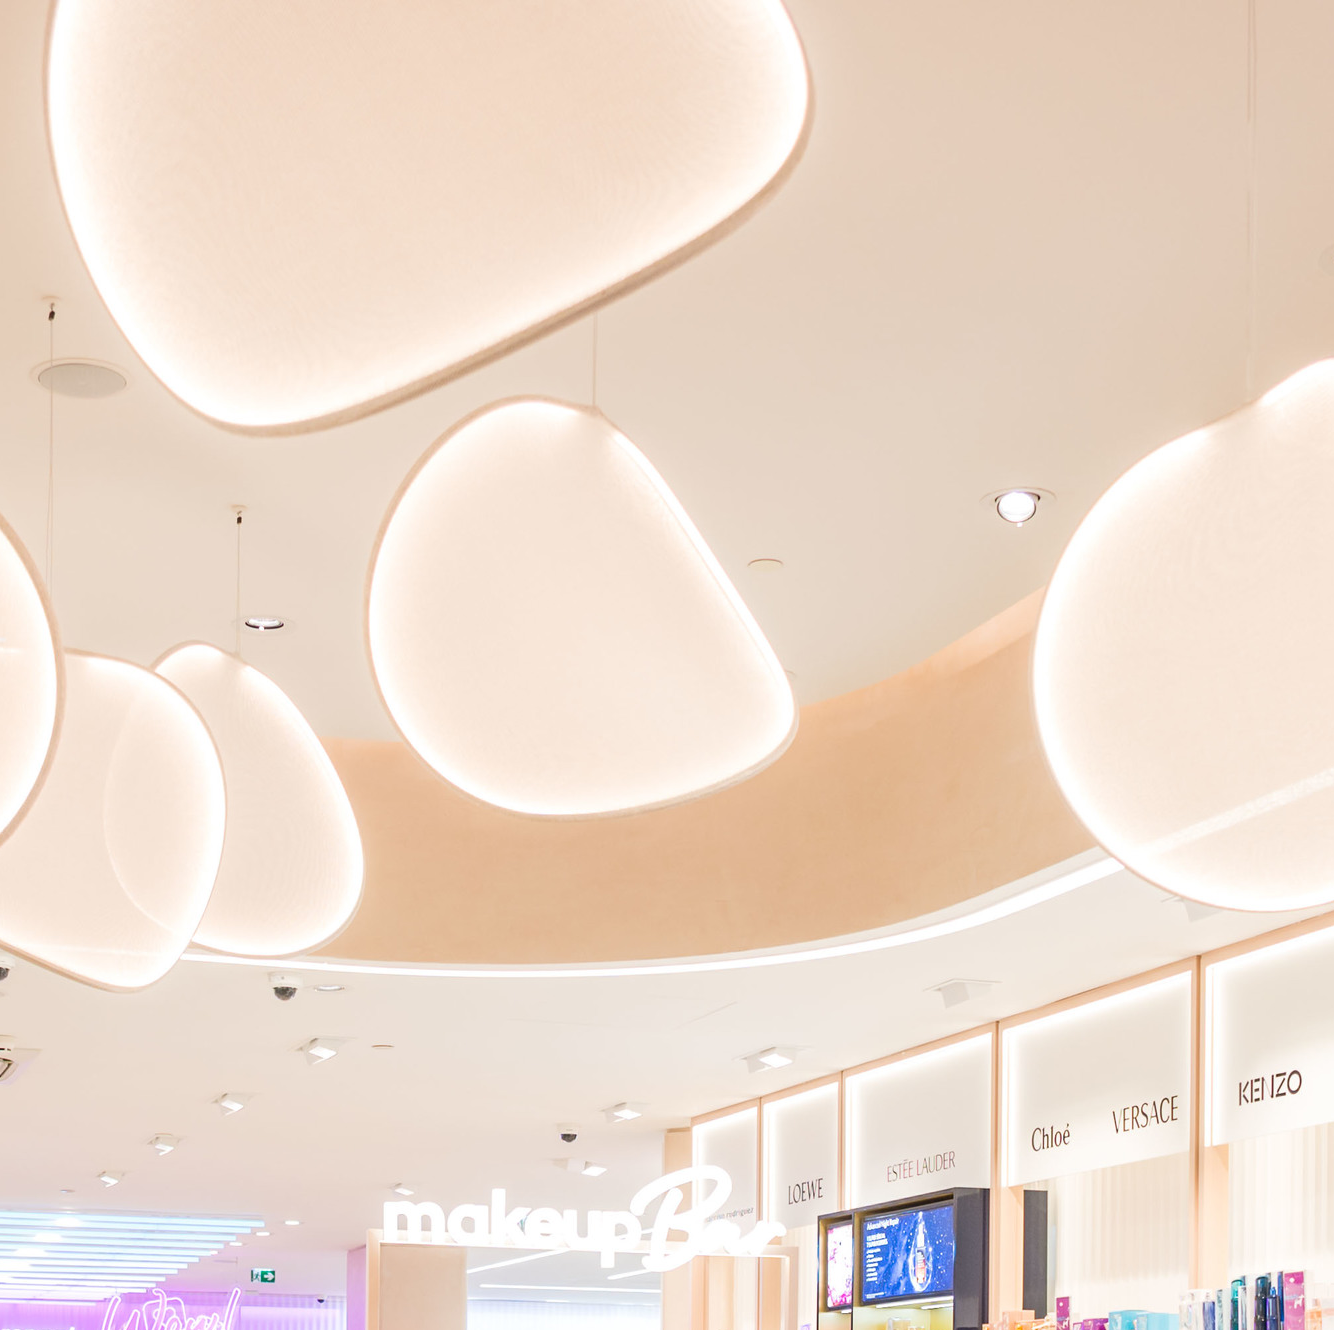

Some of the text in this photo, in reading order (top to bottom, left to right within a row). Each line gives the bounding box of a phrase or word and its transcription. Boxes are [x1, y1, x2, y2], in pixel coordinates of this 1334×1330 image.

[1238, 1069, 1302, 1106] KENZO
[1112, 1095, 1179, 1134] VERSACE
[1031, 1123, 1071, 1152] Chloé
[916, 1150, 956, 1176] LAUDER
[788, 1178, 824, 1205] LOEWE
[383, 1164, 788, 1273] makeup Bar
